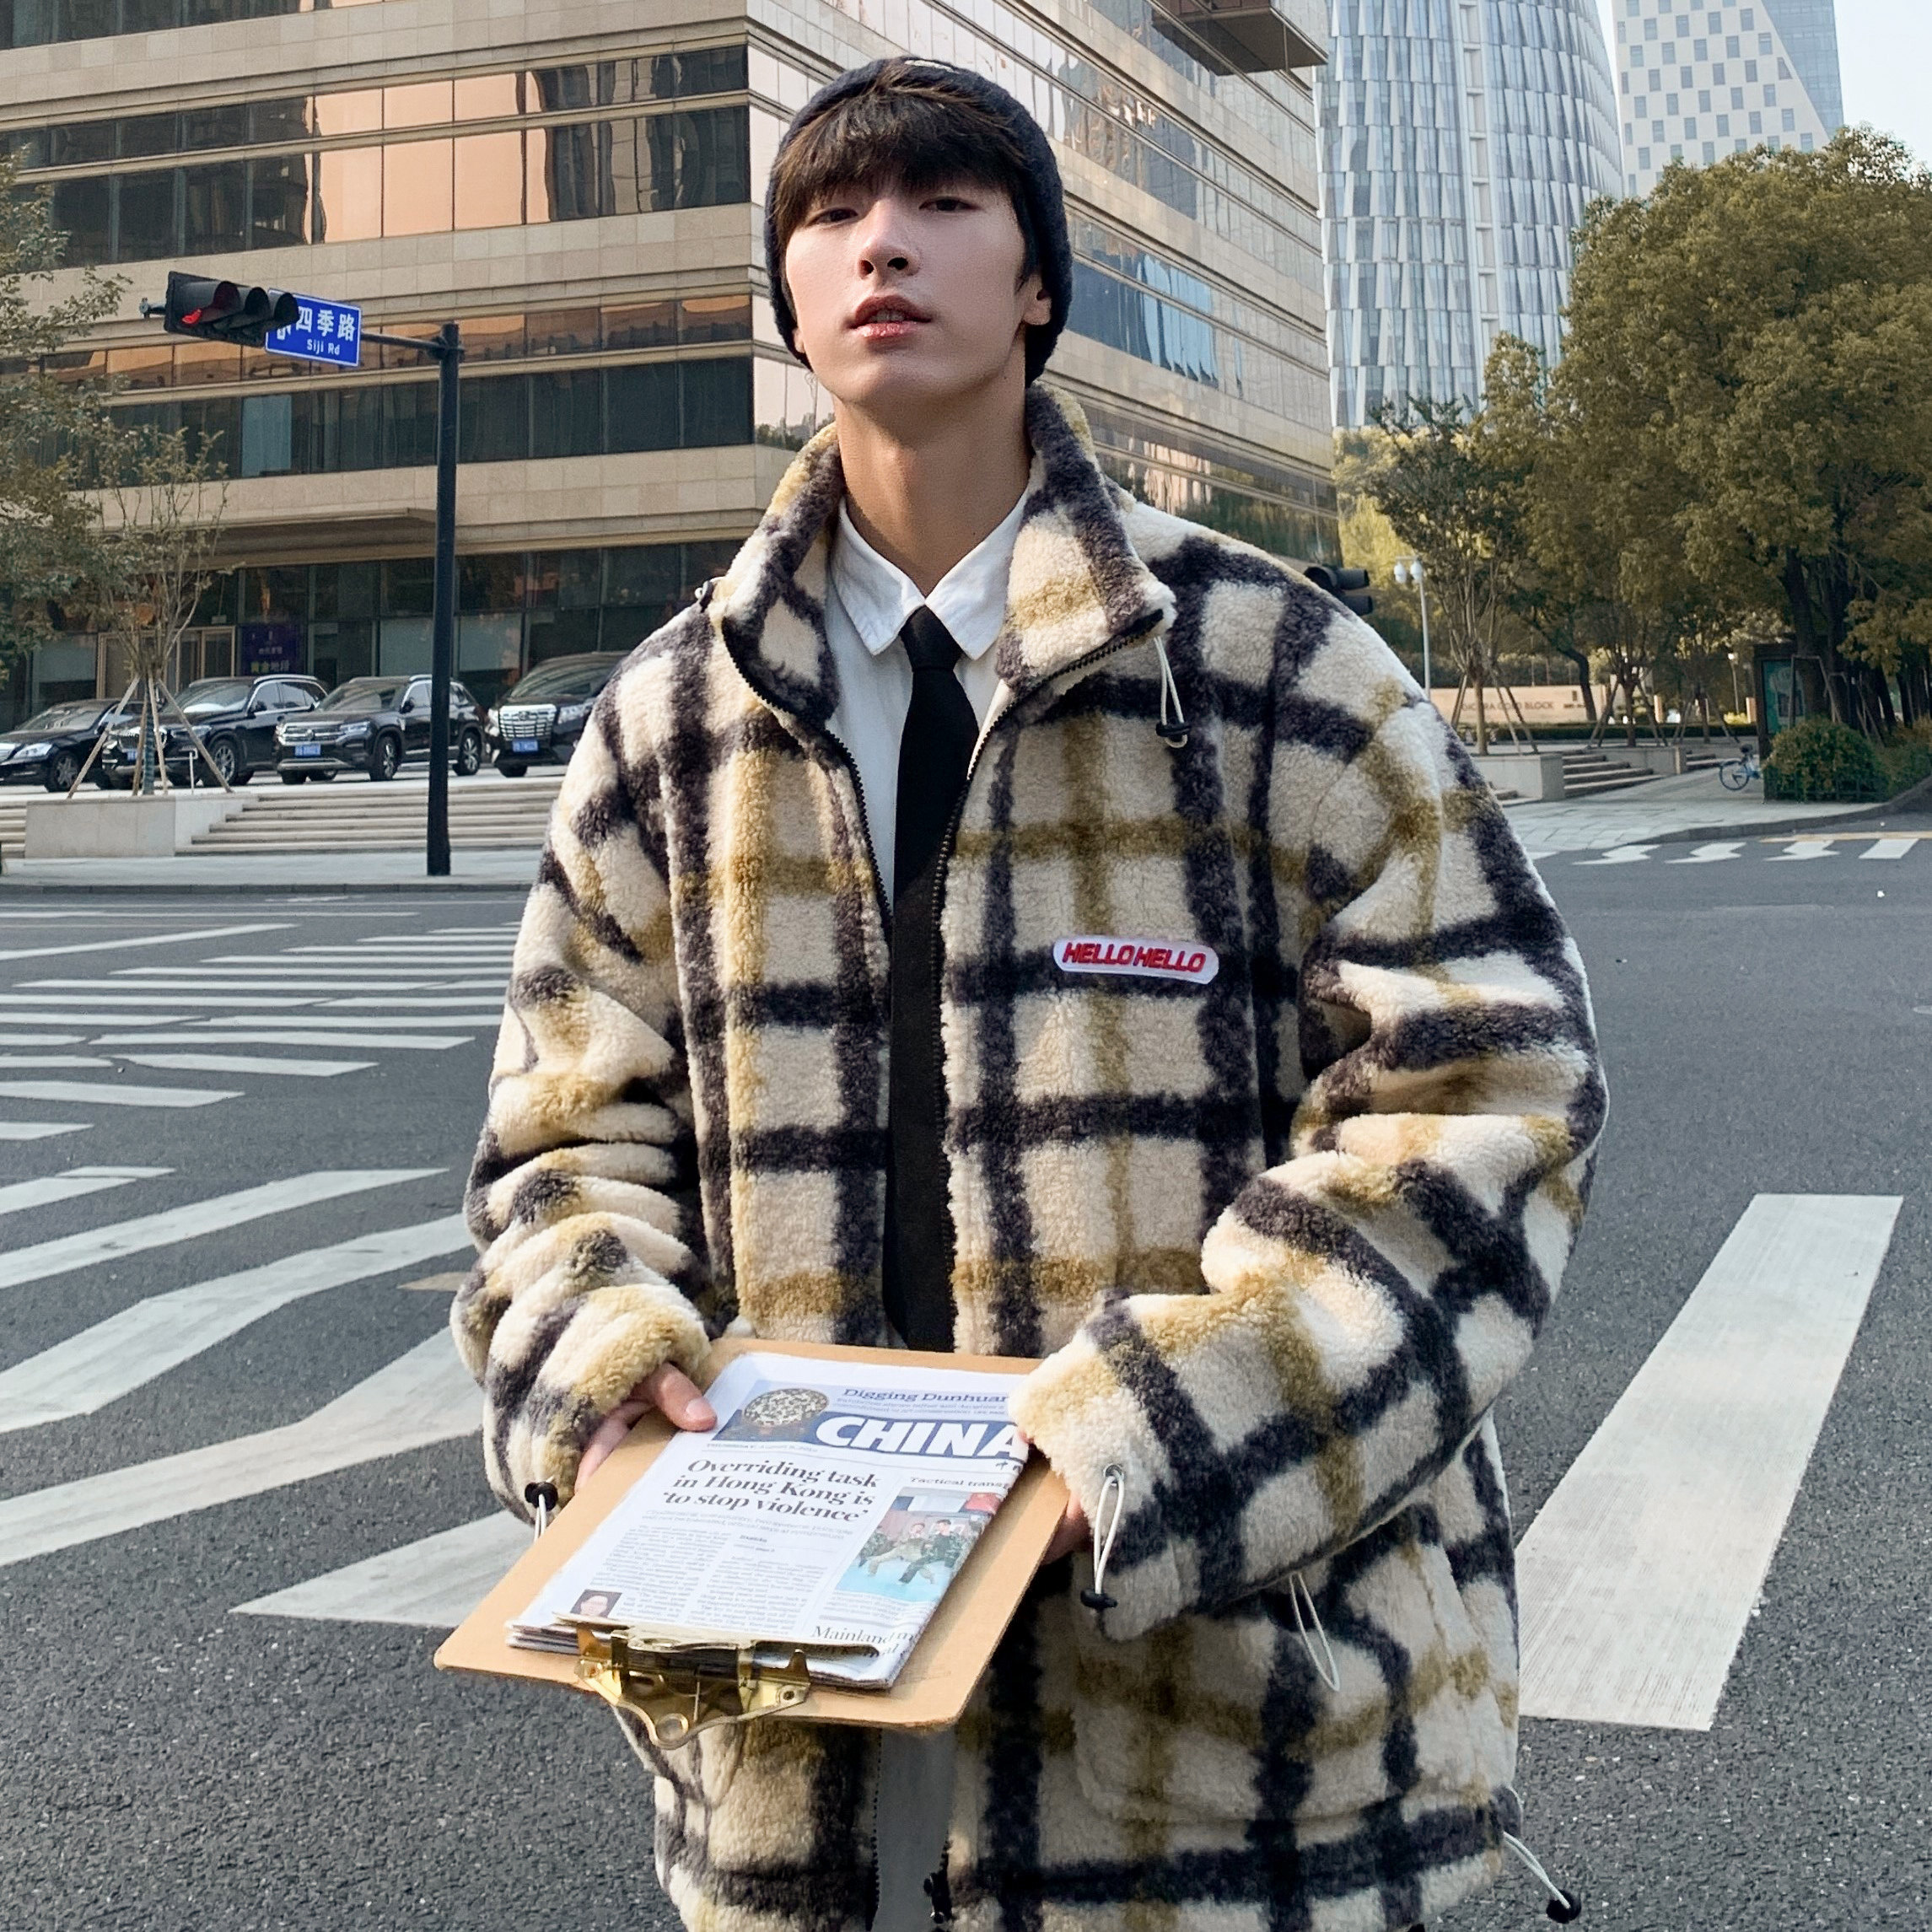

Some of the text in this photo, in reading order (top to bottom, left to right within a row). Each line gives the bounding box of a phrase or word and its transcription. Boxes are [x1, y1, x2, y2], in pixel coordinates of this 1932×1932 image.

[296, 306, 355, 342] 四季路
[307, 339, 340, 355] Siji Rd
[1525, 701, 1553, 709] BLOCK
[843, 1389, 918, 1402] Digging
[815, 1416, 1025, 1460] CHINA
[687, 1460, 880, 1488] Overriding task
[911, 1477, 964, 1486] Tactical
[674, 1475, 875, 1505] in Hong Kong is
[694, 1493, 750, 1511] stop
[811, 1626, 896, 1644] Mainland
